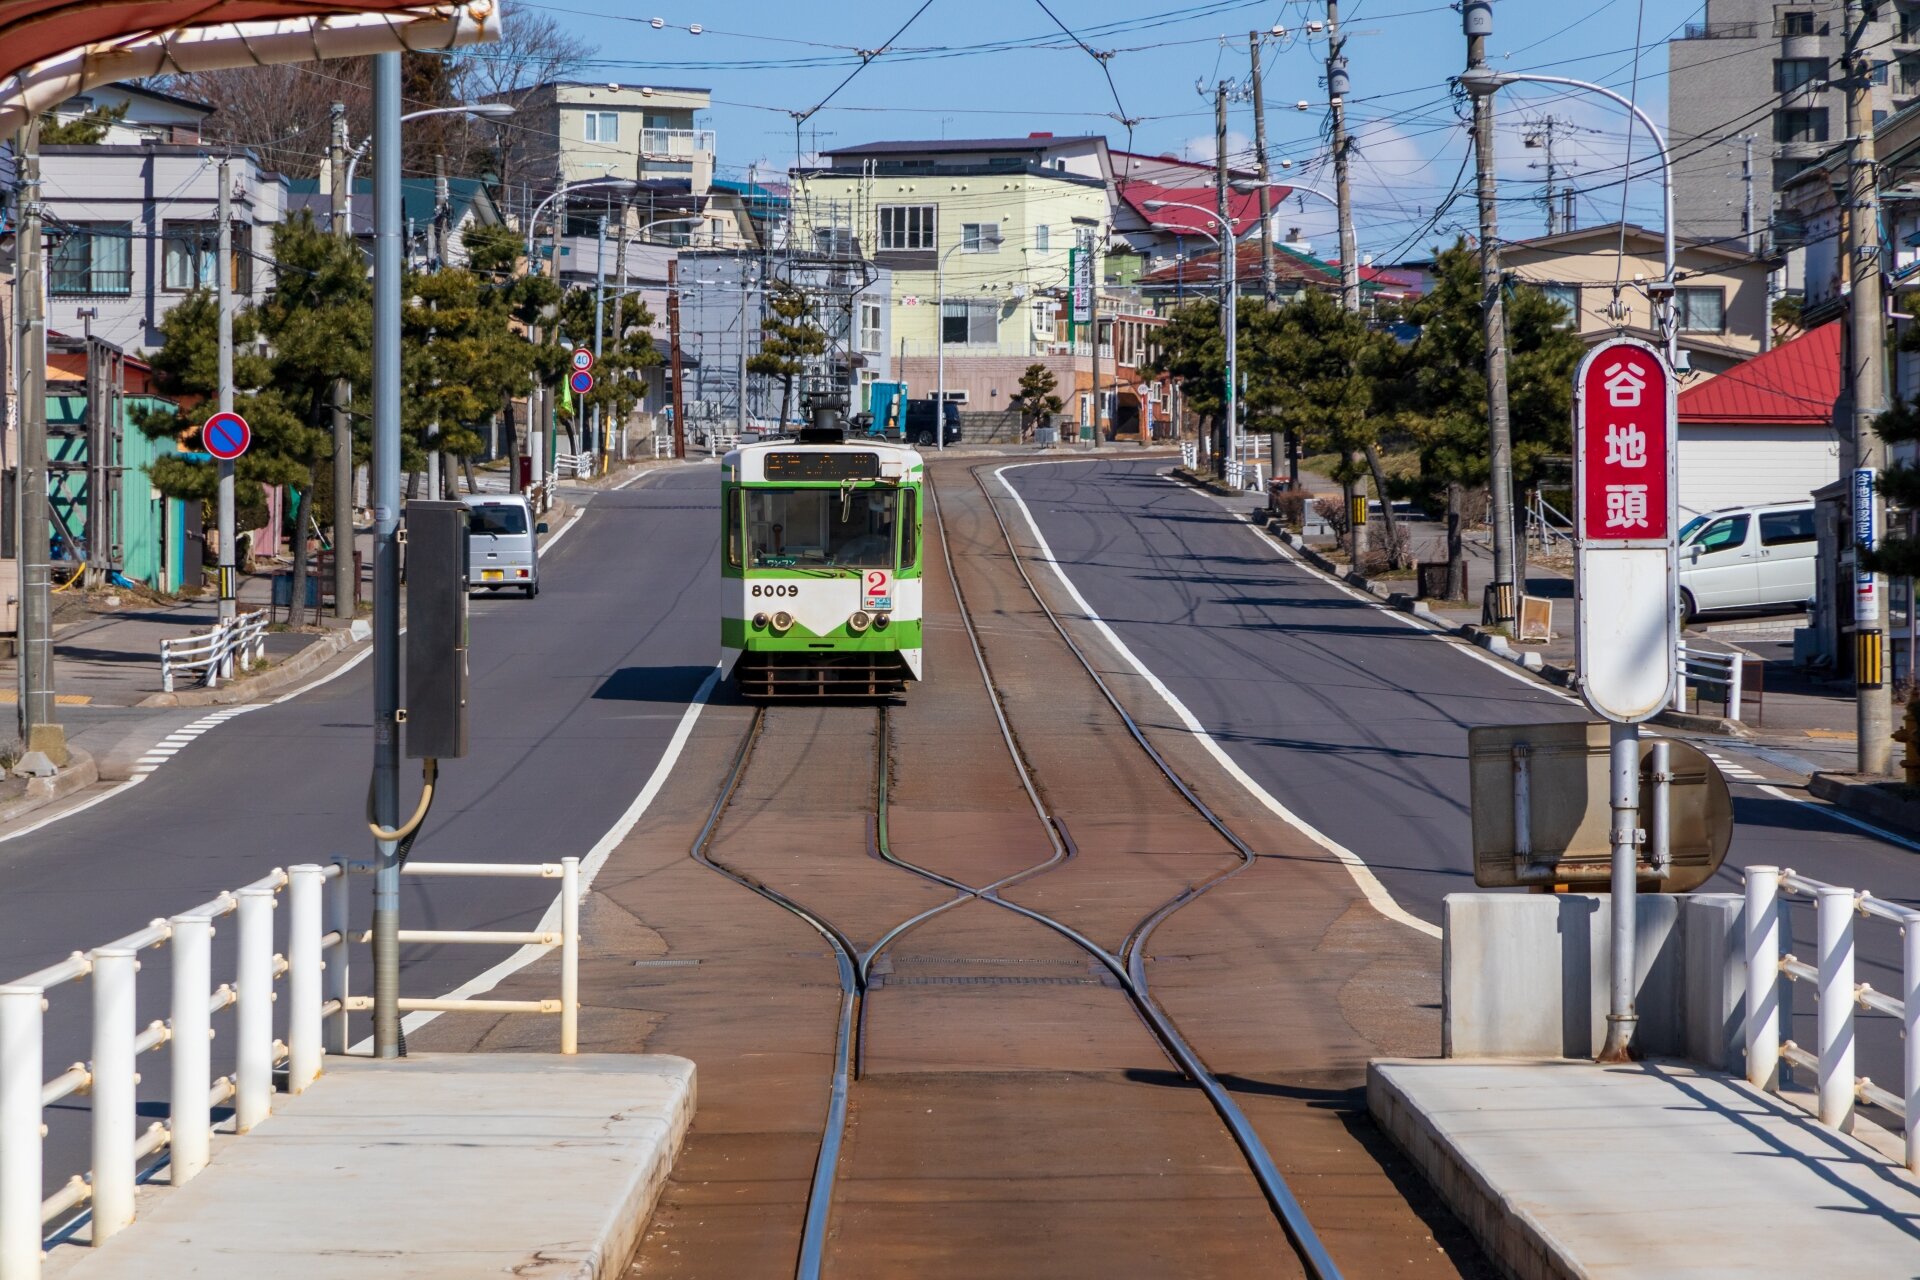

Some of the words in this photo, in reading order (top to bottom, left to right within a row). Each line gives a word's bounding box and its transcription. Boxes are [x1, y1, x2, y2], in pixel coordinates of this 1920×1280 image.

[576, 356, 587, 364] 40
[1604, 362, 1649, 528] 谷地頭
[752, 585, 799, 597] 8009
[868, 571, 887, 596] 2
